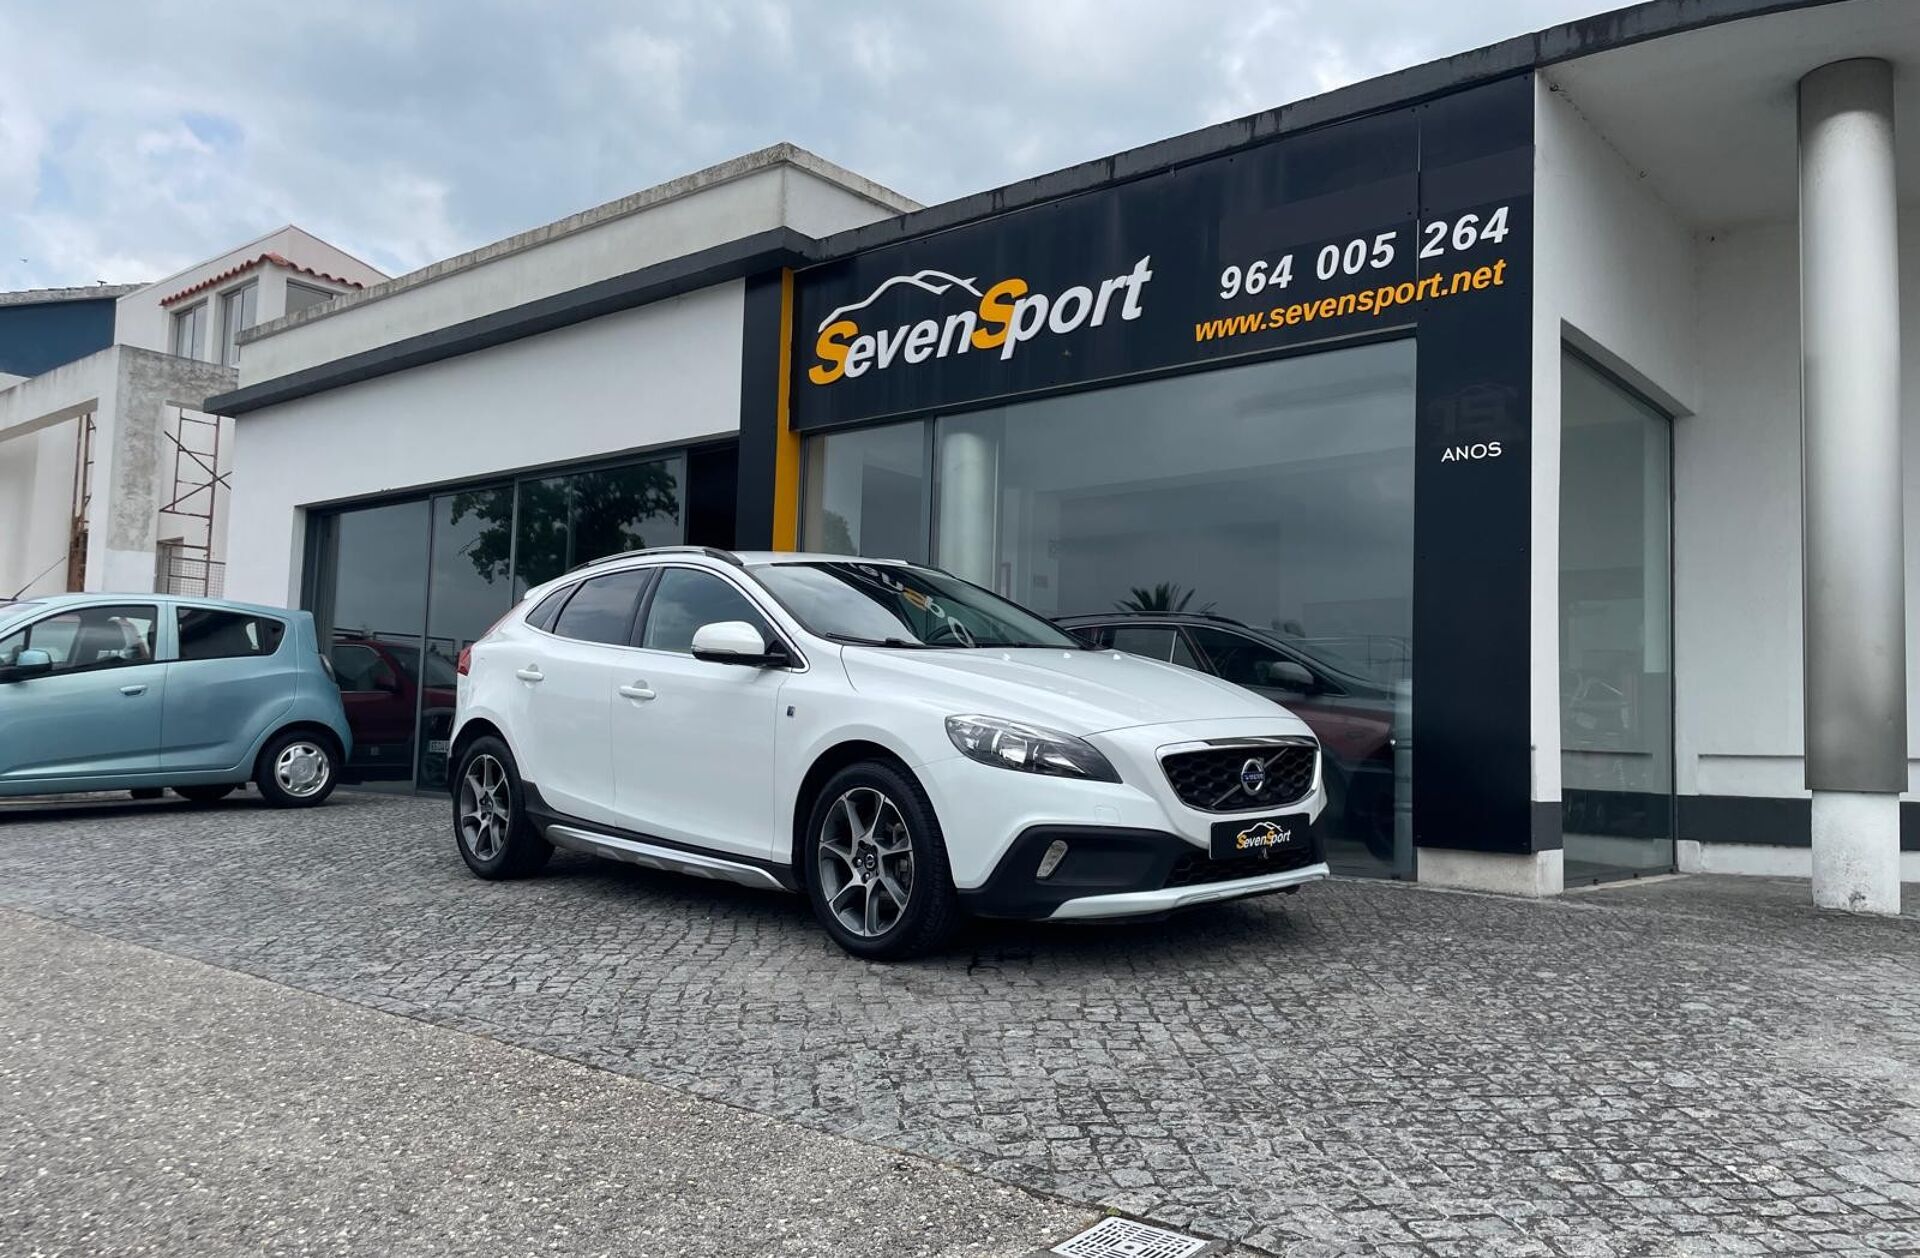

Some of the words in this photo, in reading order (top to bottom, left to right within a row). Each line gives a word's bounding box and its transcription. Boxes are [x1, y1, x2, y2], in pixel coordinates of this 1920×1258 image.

[1219, 254, 1294, 300] 964
[1316, 231, 1397, 281] 005
[1419, 206, 1510, 259] 264
[808, 255, 1153, 385] SevenSport
[1194, 258, 1507, 342] www.sevensport.net
[1440, 441, 1502, 463] ANOS
[1236, 829, 1292, 850] SevenSport
